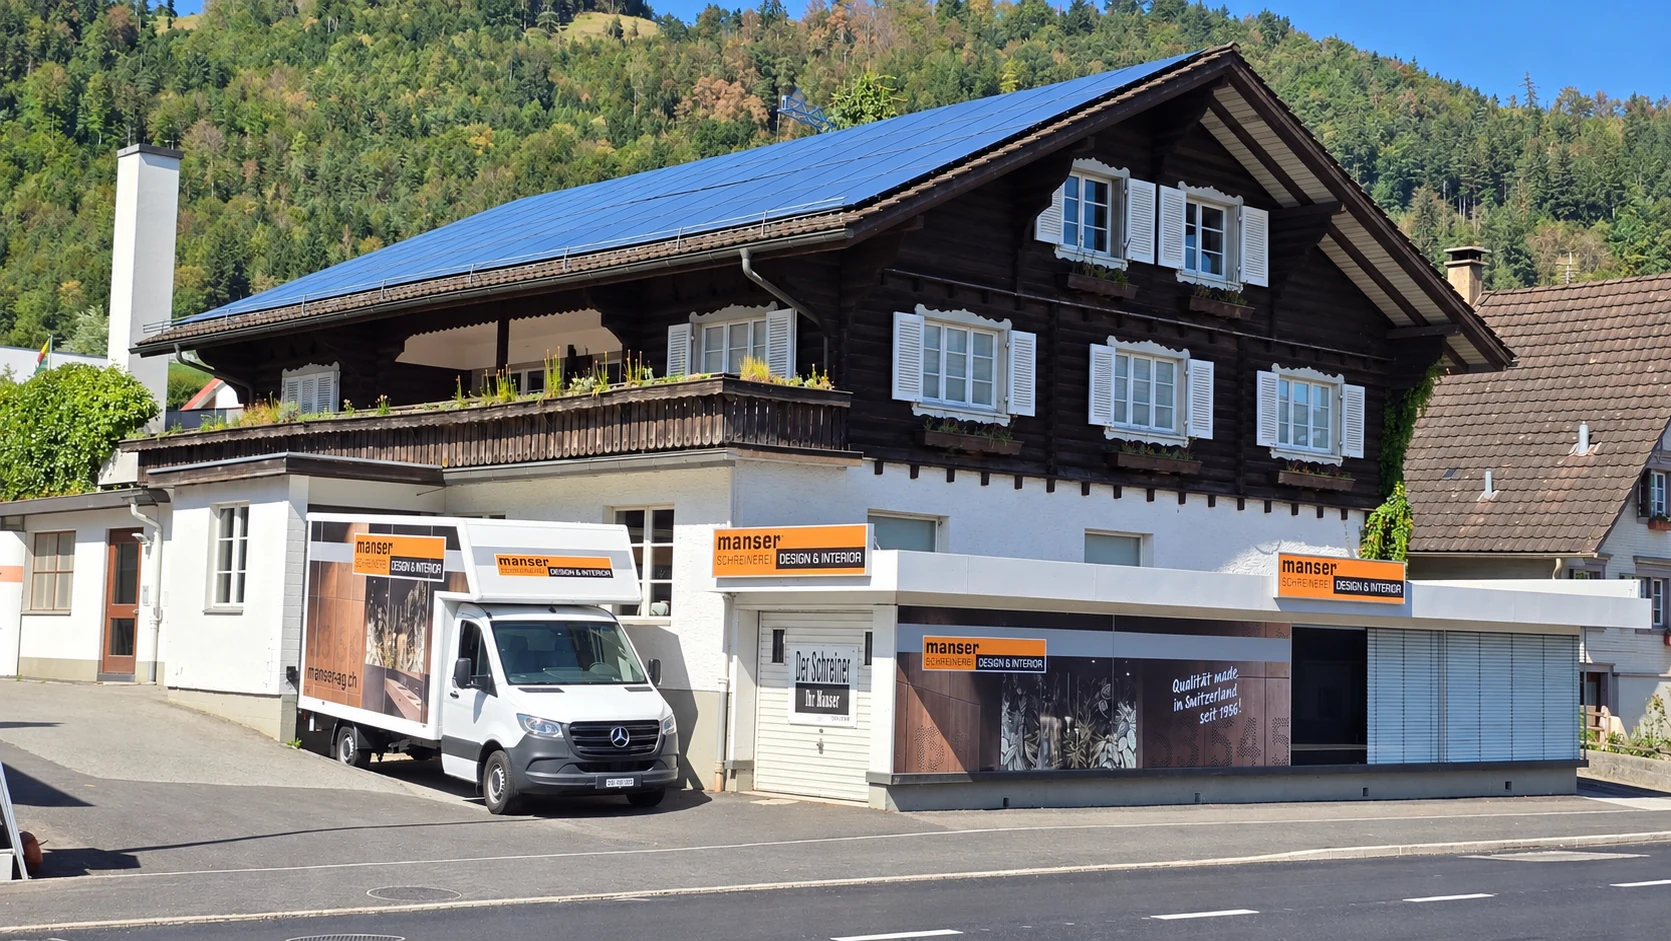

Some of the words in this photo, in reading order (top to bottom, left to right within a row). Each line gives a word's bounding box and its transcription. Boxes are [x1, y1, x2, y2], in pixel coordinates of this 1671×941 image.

[356, 541, 393, 555] manser
[718, 534, 781, 550] manser
[499, 557, 549, 567] manser
[717, 554, 773, 566] SCHREINEREI
[779, 553, 811, 565] DESIGN
[812, 553, 819, 564] &
[821, 551, 862, 563] INTERIOR
[1282, 560, 1337, 575] manser
[1281, 577, 1331, 589] SCHREINEREI
[1336, 580, 1362, 591] DESIGN
[1363, 581, 1369, 591] &
[1370, 582, 1402, 594] INTERIOR
[926, 642, 979, 655] manser
[796, 651, 810, 681] Der
[811, 651, 851, 683] Schreiner
[926, 657, 974, 667] SCHREINEREI
[978, 658, 1004, 668] DESIGN
[1005, 658, 1011, 668] &
[1011, 659, 1043, 669] INTERIOR
[308, 667, 358, 691] manser-agch
[1172, 672, 1212, 693] Qualität
[1214, 666, 1239, 684] made
[1173, 698, 1183, 712] in
[1185, 683, 1238, 709] Switzerland
[1200, 707, 1218, 725] seit
[1220, 697, 1242, 719] 1956!
